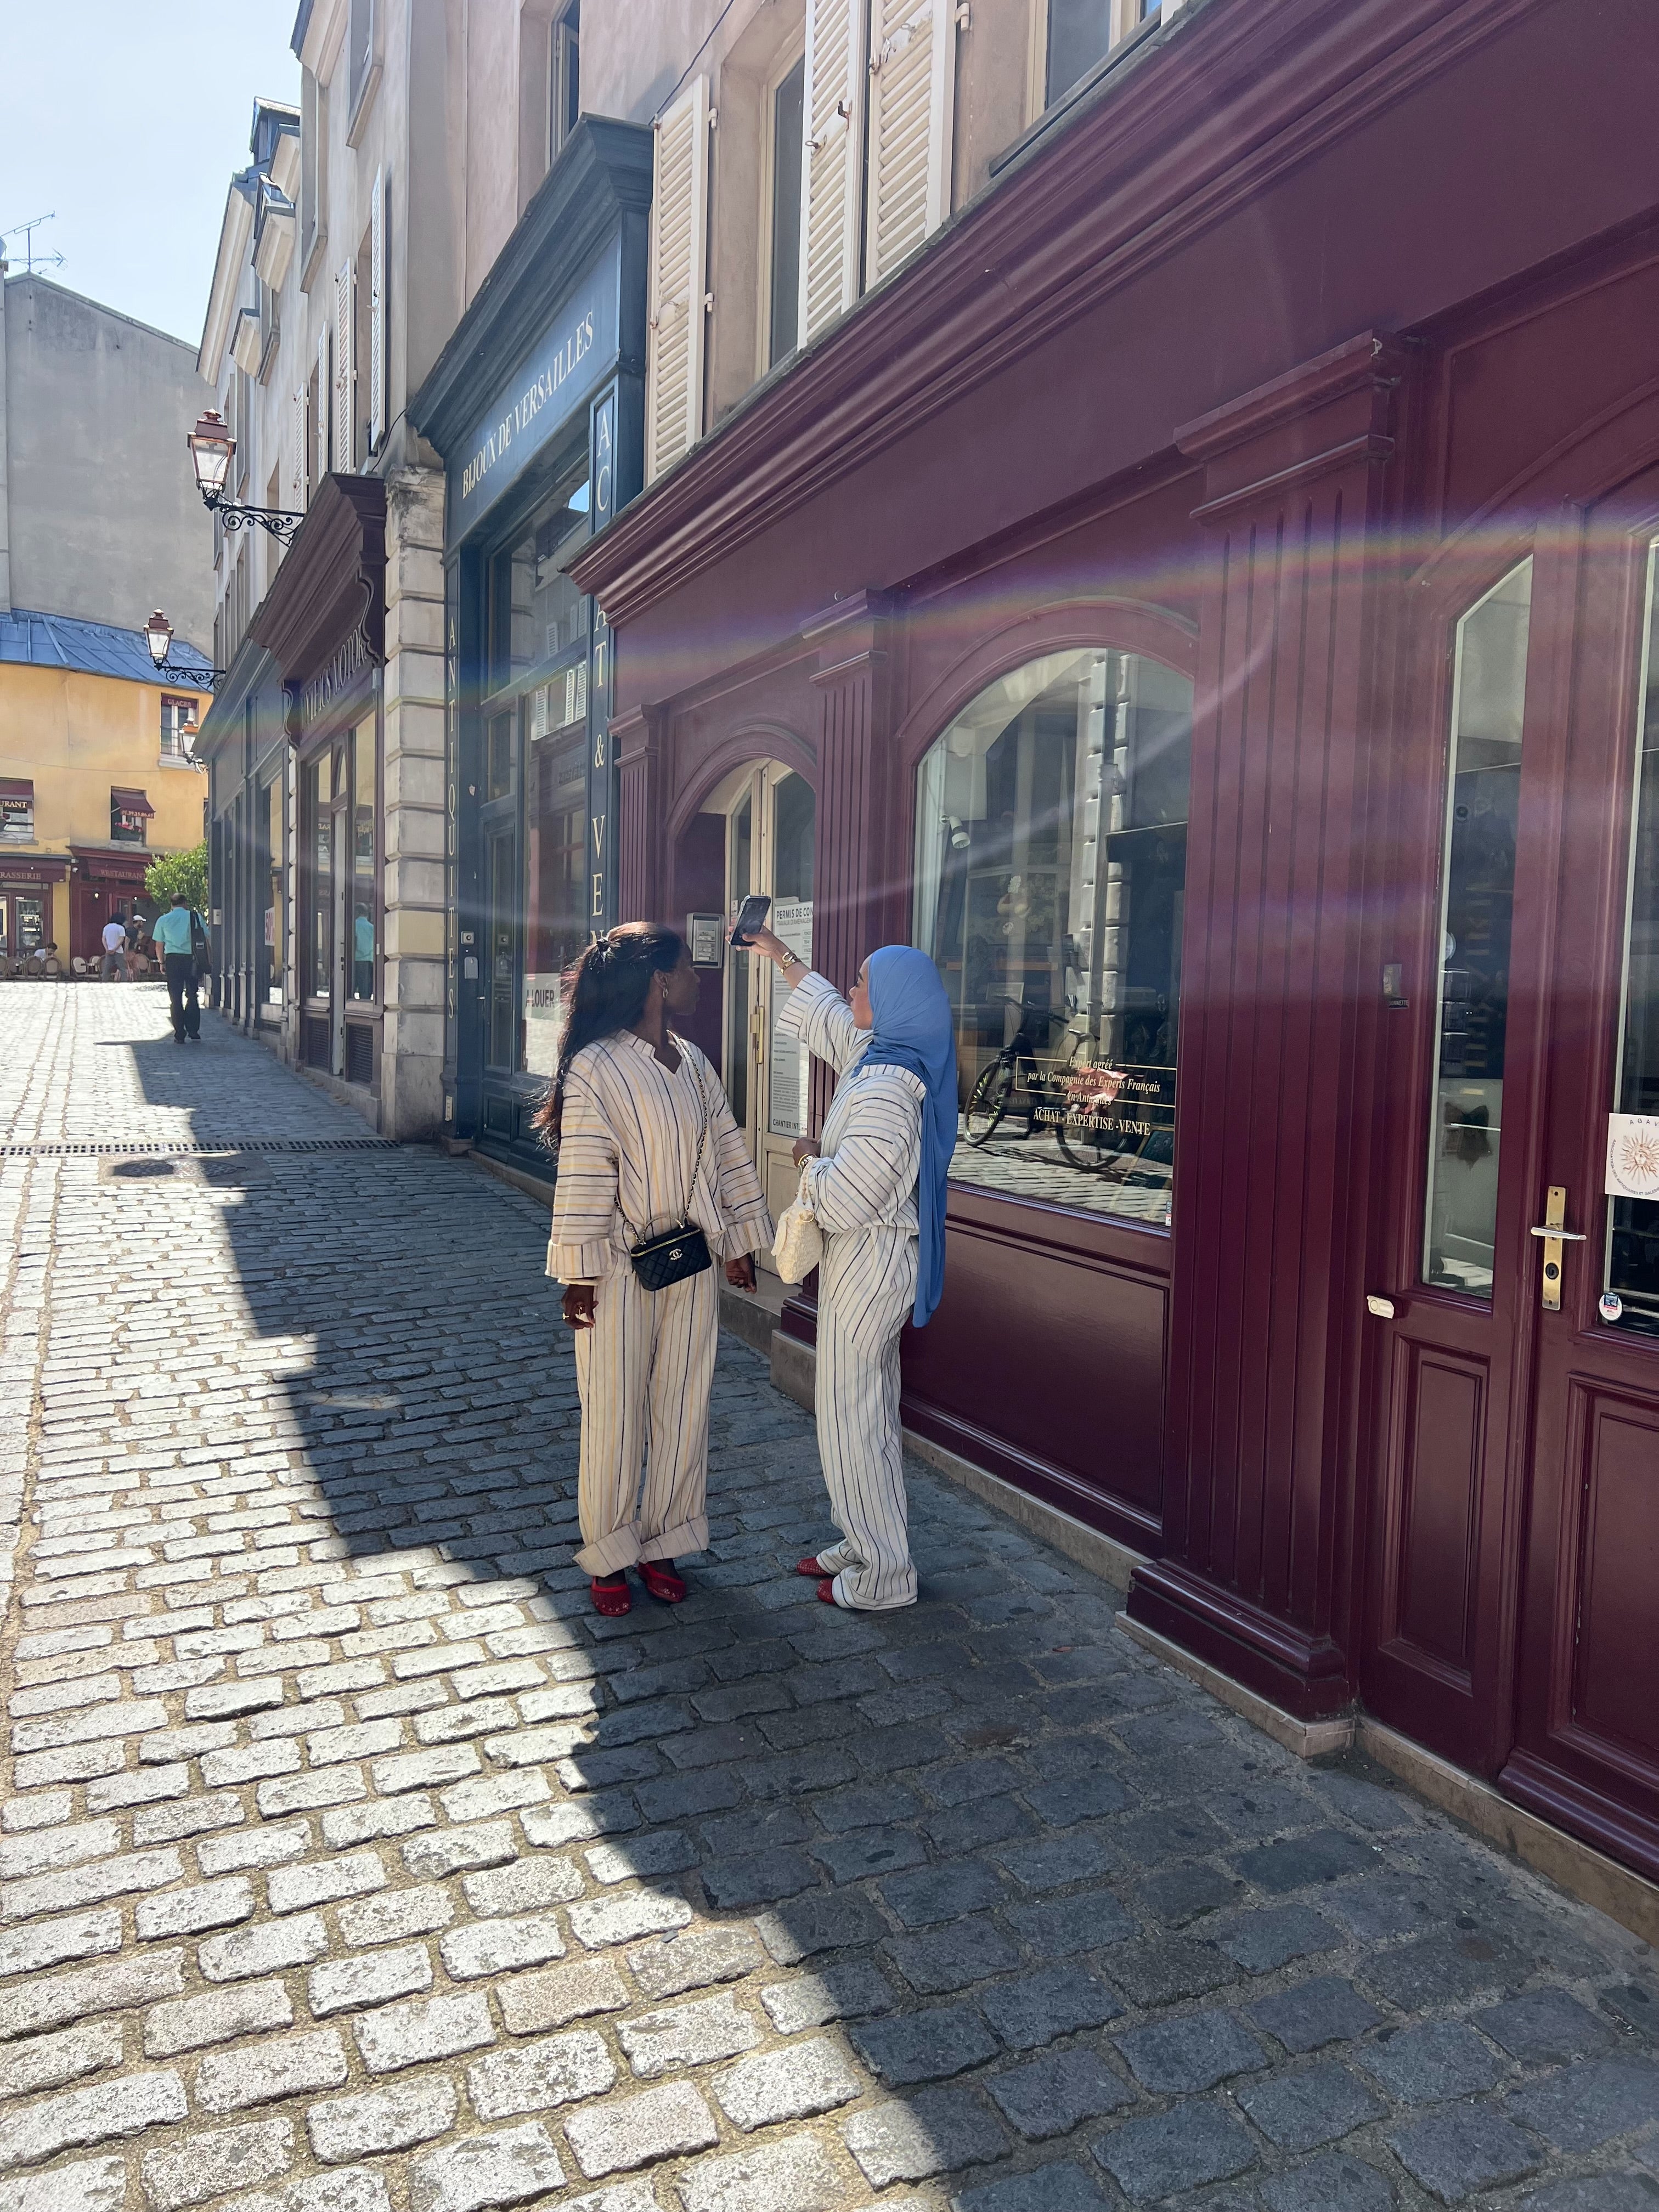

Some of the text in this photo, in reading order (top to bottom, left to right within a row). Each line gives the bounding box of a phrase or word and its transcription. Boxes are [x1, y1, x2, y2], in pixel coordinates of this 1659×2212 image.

[462, 311, 592, 500] BIJOUX DE VERSAILLES
[595, 733, 605, 768] &
[448, 616, 456, 1019] ANTIQUITES
[0, 872, 41, 880] RASSERIE
[776, 909, 794, 919] PERMIS
[796, 908, 802, 917] DE
[1069, 1056, 1113, 1071] Expert agréé
[1027, 1071, 1161, 1094] par la Compagnie des Experts Français
[773, 1119, 792, 1129] CHANTIER
[1034, 1109, 1060, 1123] ACHAT
[1066, 1113, 1114, 1131] EXPERTISE
